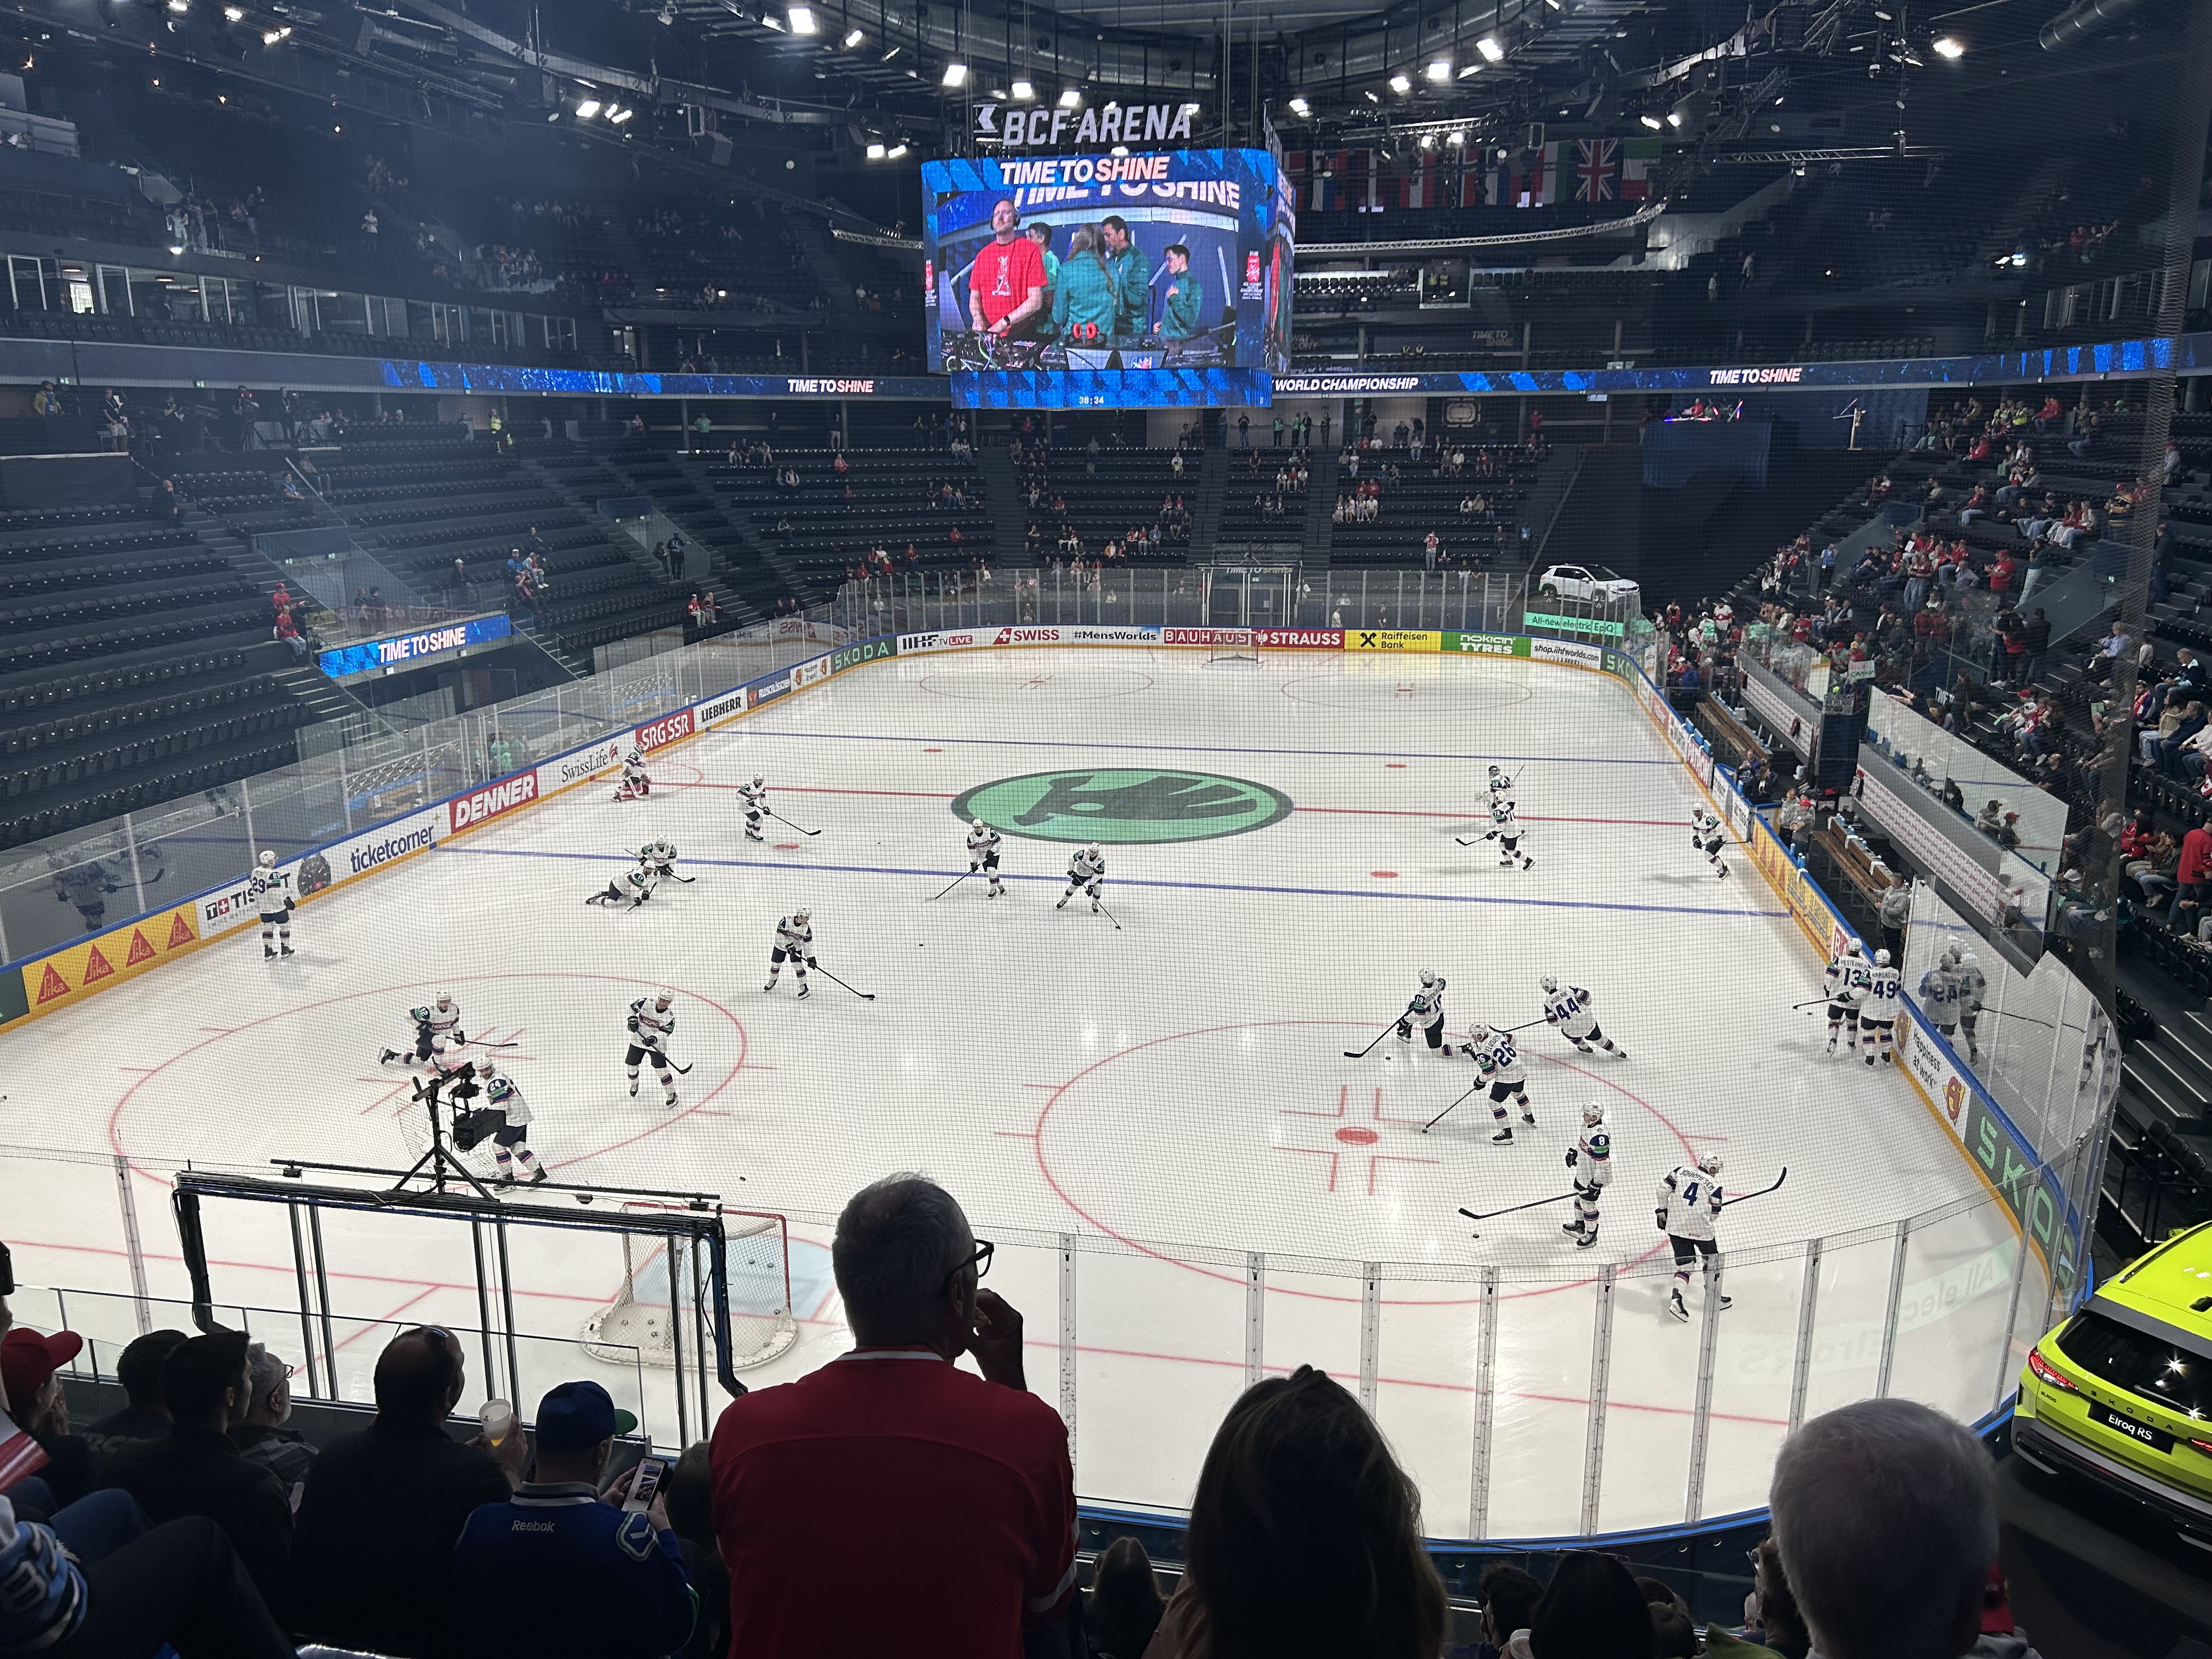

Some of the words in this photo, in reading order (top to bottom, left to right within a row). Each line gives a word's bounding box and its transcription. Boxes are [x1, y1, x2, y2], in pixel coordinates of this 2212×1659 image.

[1003, 109, 1071, 146] BCF
[1074, 103, 1191, 144] ARENA
[1000, 160, 1058, 185] TIME
[1060, 158, 1093, 183] TO
[1094, 155, 1171, 182] SHINE
[1471, 330, 1494, 339] TIME
[1496, 330, 1508, 338] TO
[1485, 337, 1514, 346] SHINE
[1275, 379, 1321, 391] WORLD
[1321, 377, 1419, 391] CHAMPIONSHIP
[1709, 369, 1739, 384] TIME
[1740, 369, 1759, 383] TO
[1760, 367, 1802, 383] SHINE
[788, 379, 817, 393] TIME
[819, 379, 836, 393] TO
[837, 380, 874, 393] SHINE
[950, 635, 972, 645] LIVE
[1014, 629, 1059, 641] SWISS
[1074, 630, 1156, 642] #MensWorlds
[1164, 630, 1248, 644] BAUHAUS
[1270, 632, 1341, 646] STRAUSS
[1381, 631, 1428, 641] Raiffeisen
[378, 639, 411, 664] TIME
[410, 635, 430, 656] TO
[429, 626, 466, 652] SHINE
[1381, 641, 1404, 650] Bank
[1460, 642, 1513, 654] TYRES
[701, 696, 742, 723] LIEBHERR
[641, 721, 666, 751] SRG
[665, 713, 690, 741] SSR
[454, 774, 535, 828] DENNER
[351, 825, 435, 873] ticketcorner
[230, 872, 290, 909] TIST
[252, 877, 267, 894] 29
[170, 922, 191, 946] Sika
[129, 939, 151, 963] Sika
[86, 956, 109, 981] Sika
[1844, 967, 1863, 987] 13
[40, 973, 65, 1000] Sika
[1874, 980, 1897, 999] 49
[1556, 997, 1581, 1020] 44
[1493, 1041, 1517, 1067] 26
[1912, 1028, 1940, 1073] Happiness
[1912, 1054, 1920, 1071] at
[1920, 1065, 1934, 1090] work
[489, 1080, 502, 1092] 24
[1598, 1136, 1606, 1147] 8
[1683, 1182, 1699, 1206] 4
[2041, 1391, 2057, 1403] ELROQ
[2108, 1414, 2136, 1435] Elroq
[2137, 1426, 2153, 1440] RS
[512, 1520, 555, 1533] Reebok
